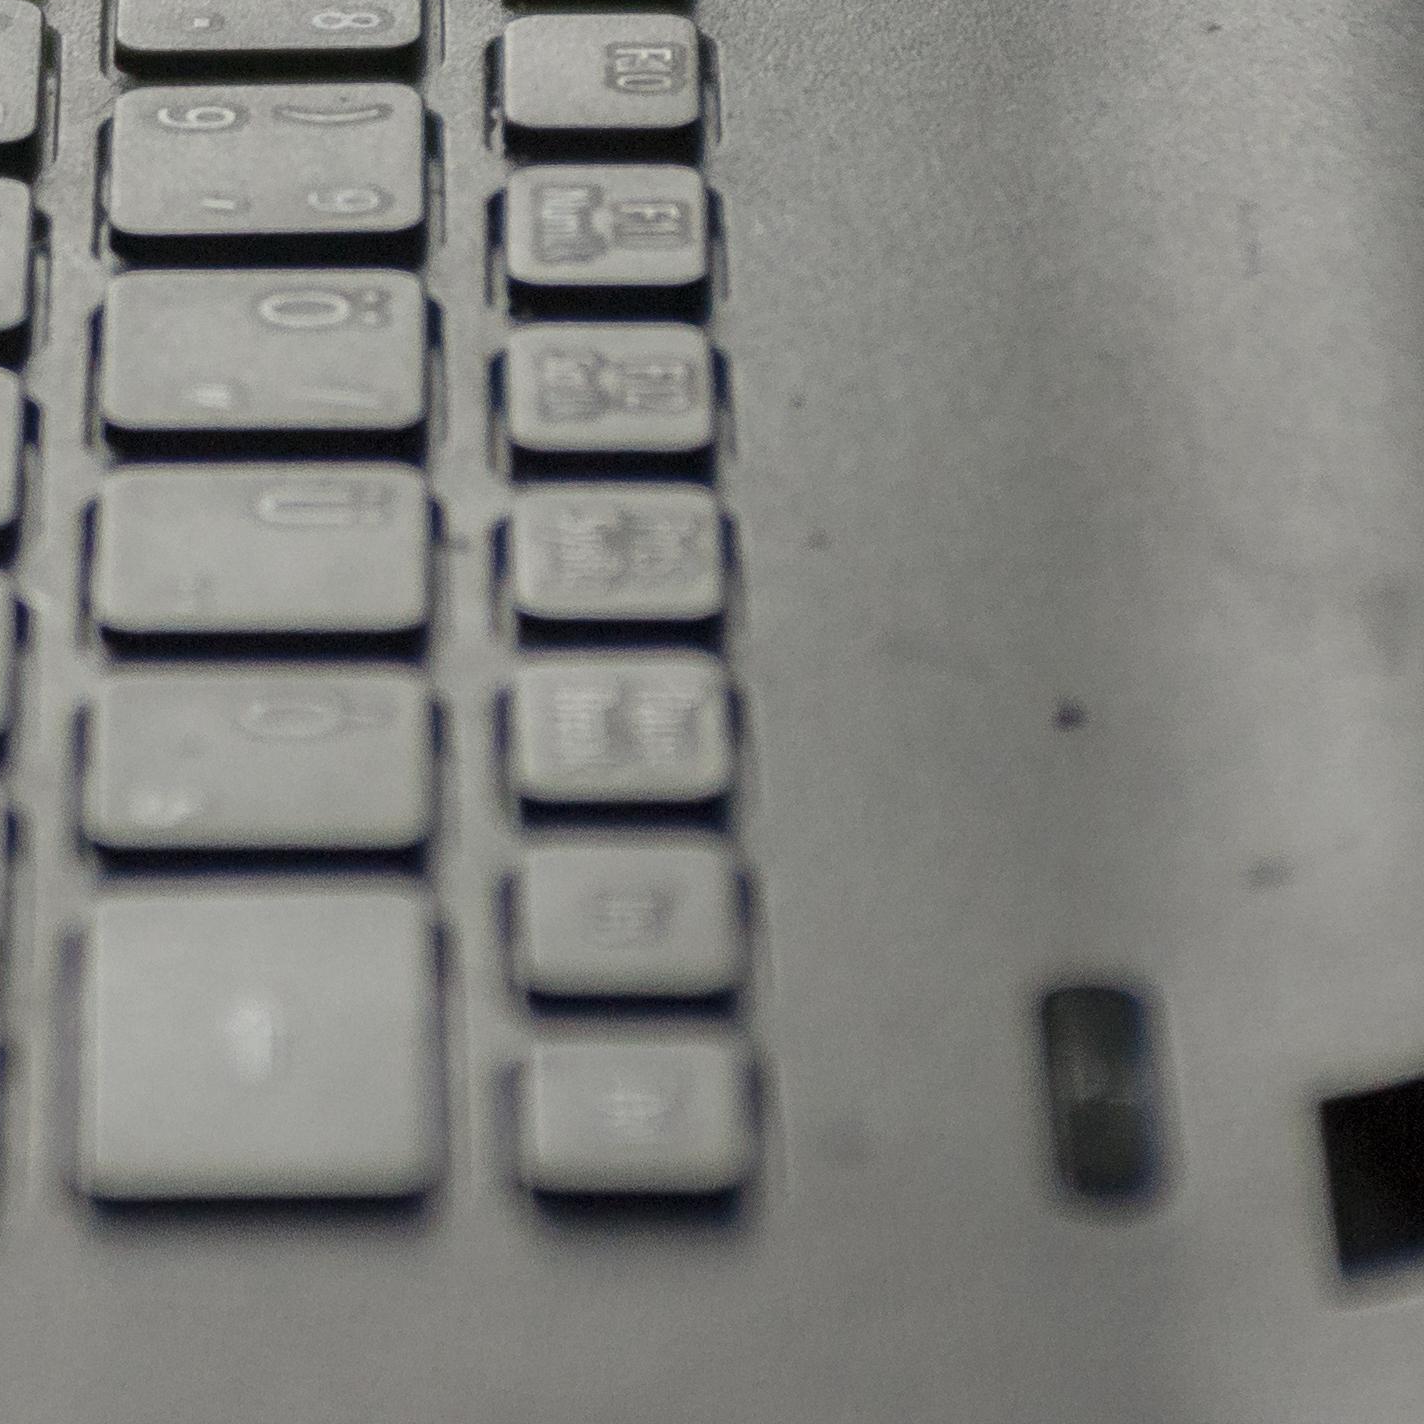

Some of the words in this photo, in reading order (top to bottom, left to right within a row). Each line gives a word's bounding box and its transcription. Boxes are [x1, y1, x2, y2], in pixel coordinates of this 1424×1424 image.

[311, 11, 382, 29] 8
[615, 46, 674, 90] F10
[156, 105, 238, 129] 9
[279, 107, 381, 123] )
[308, 188, 382, 213] 9
[259, 289, 383, 328] Ö
